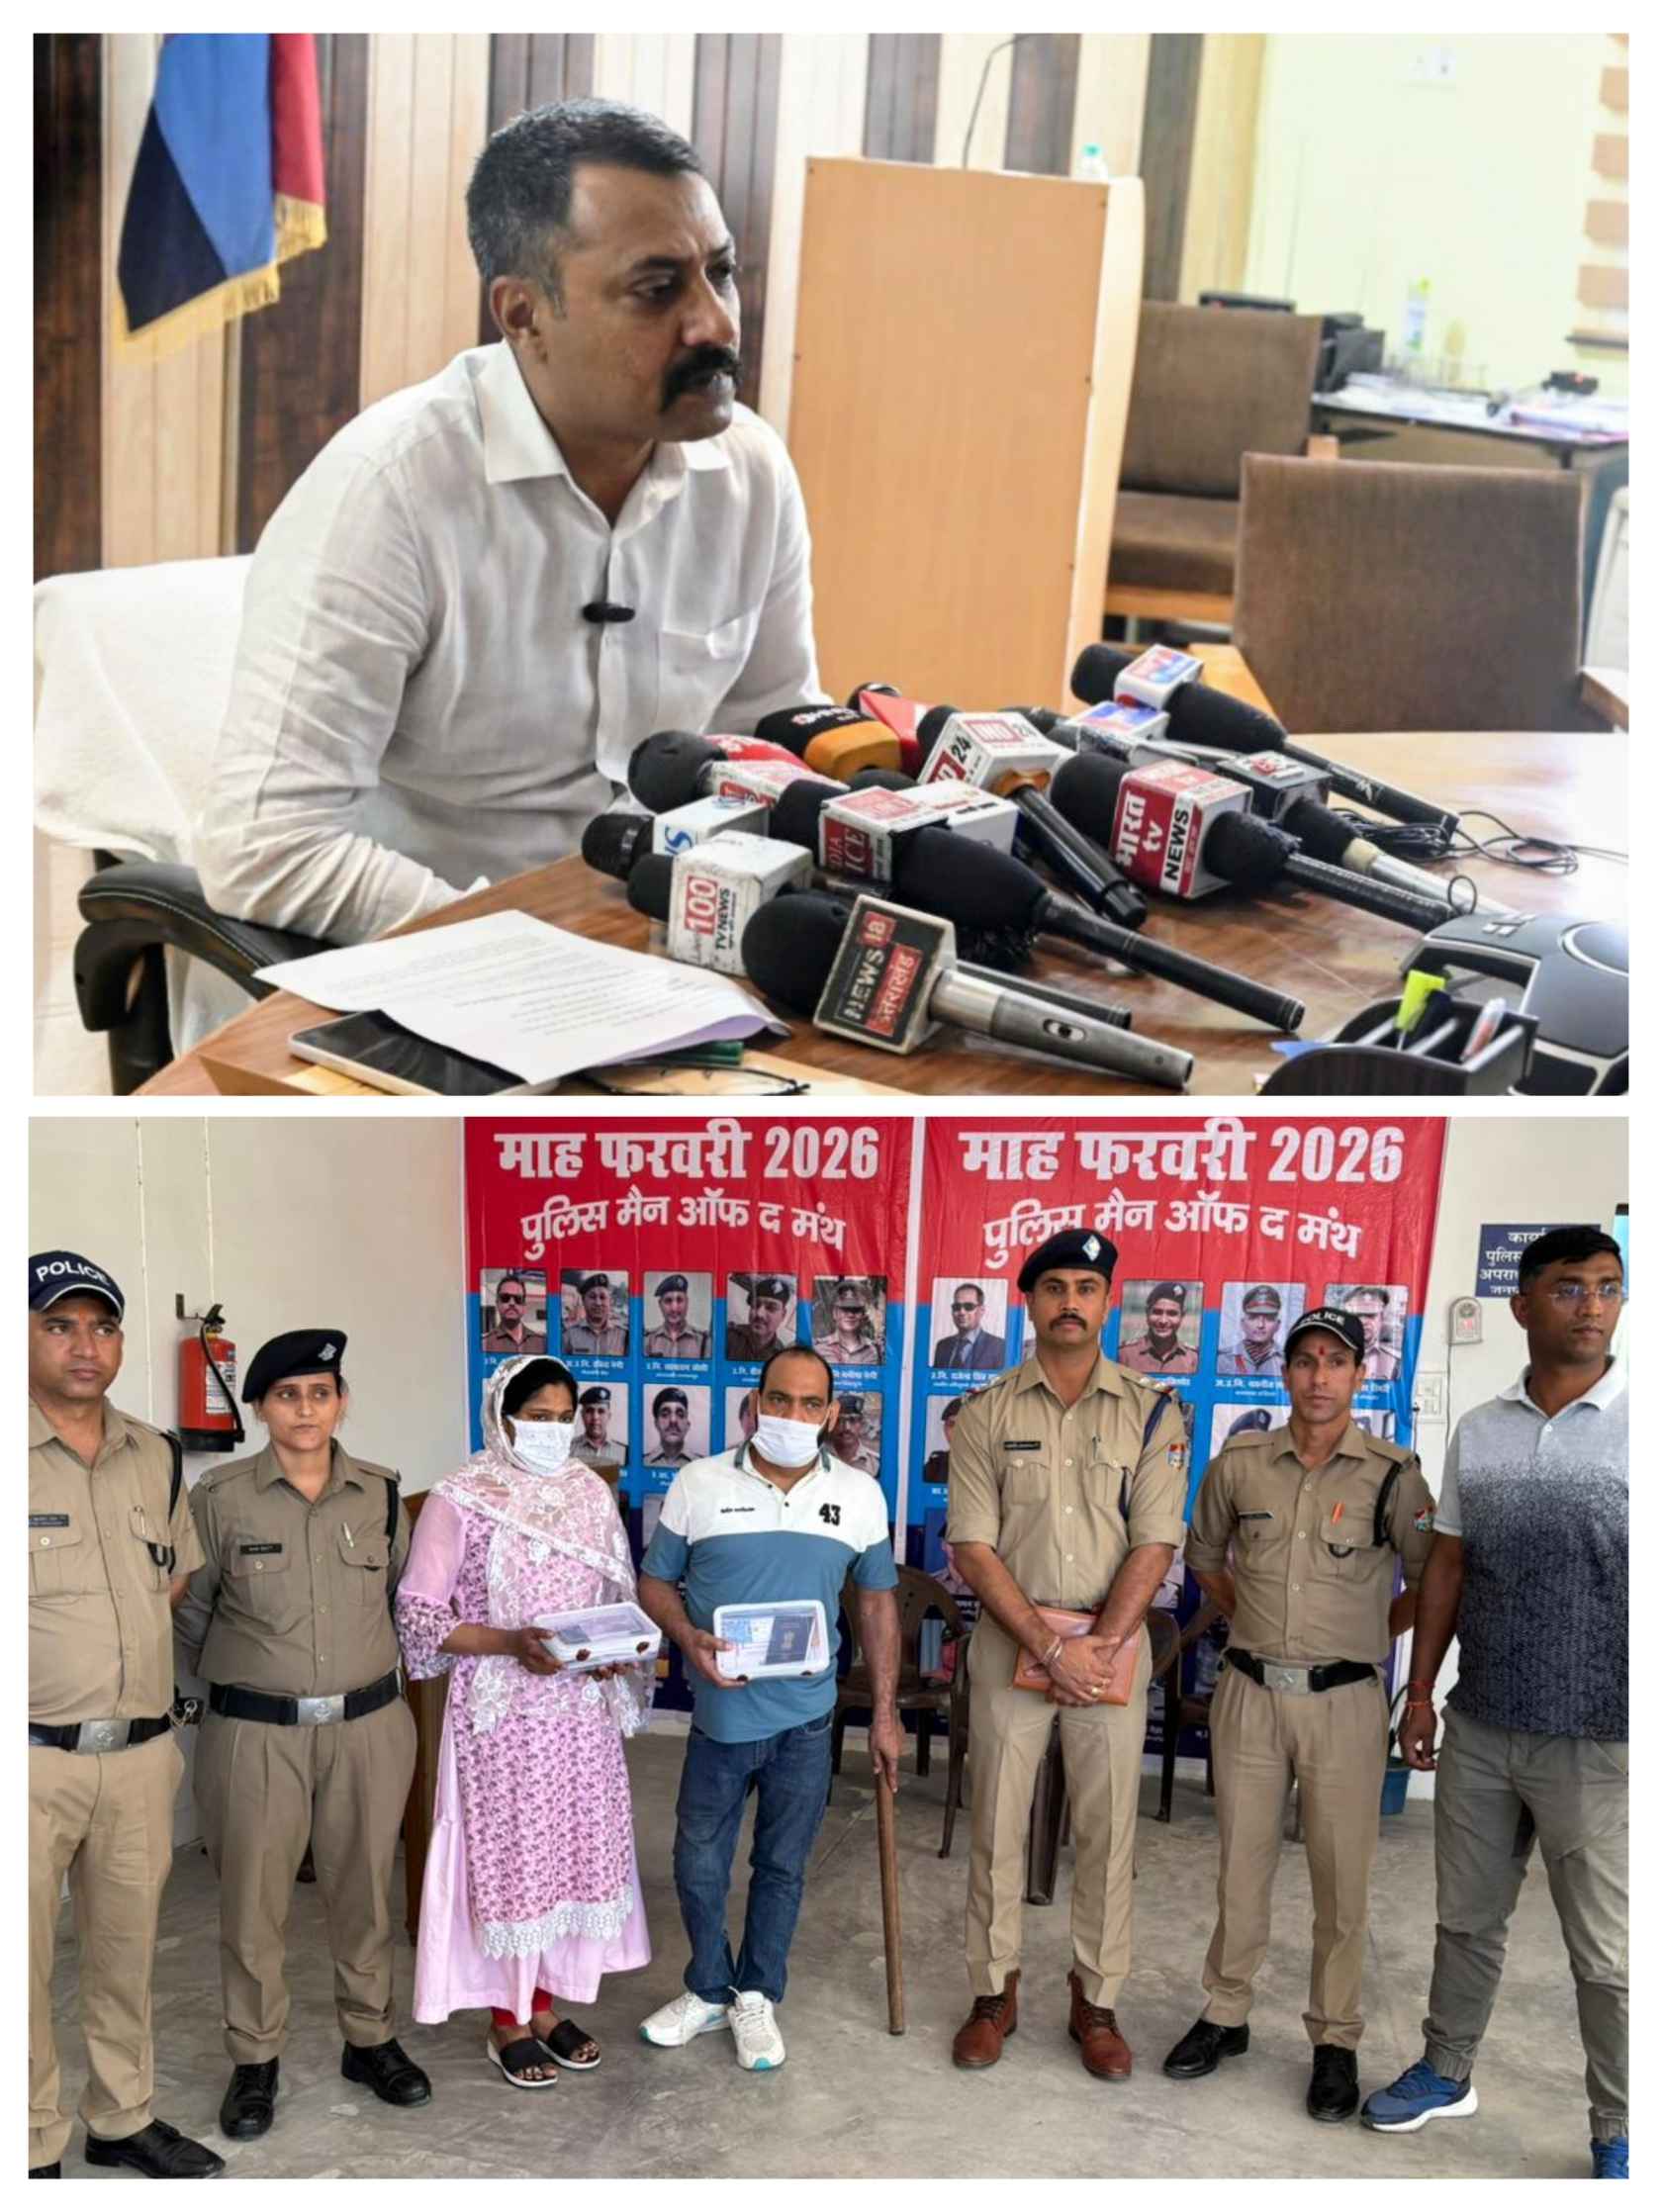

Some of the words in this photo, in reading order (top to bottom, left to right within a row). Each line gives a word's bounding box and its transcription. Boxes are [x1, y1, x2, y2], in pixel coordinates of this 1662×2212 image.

[952, 736, 972, 764] 24
[1116, 789, 1147, 868] भारत
[1142, 820, 1163, 853] tv
[1164, 808, 1189, 880] NEWS
[687, 877, 716, 930] 100
[844, 948, 885, 1021] NEWS
[495, 1134, 586, 1177] माह
[595, 1118, 752, 1179] फरवरी
[765, 1127, 878, 1178] 2026
[959, 1132, 1064, 1180] माह
[1074, 1118, 1256, 1180] फरवरी
[1268, 1127, 1404, 1182] 2026
[520, 1195, 608, 1260] पुलिस
[616, 1184, 670, 1227] मैन
[678, 1188, 749, 1227] ऑफ
[759, 1203, 785, 1233] द
[791, 1202, 846, 1250] मंथ
[982, 1199, 1085, 1268] पुलिस
[1094, 1188, 1157, 1232] मैन
[1164, 1190, 1249, 1235] ऑफ
[1259, 1208, 1290, 1242] द
[1297, 1207, 1361, 1257] मंथ
[36, 1260, 111, 1287] POLICE
[818, 1502, 842, 1526] 43
